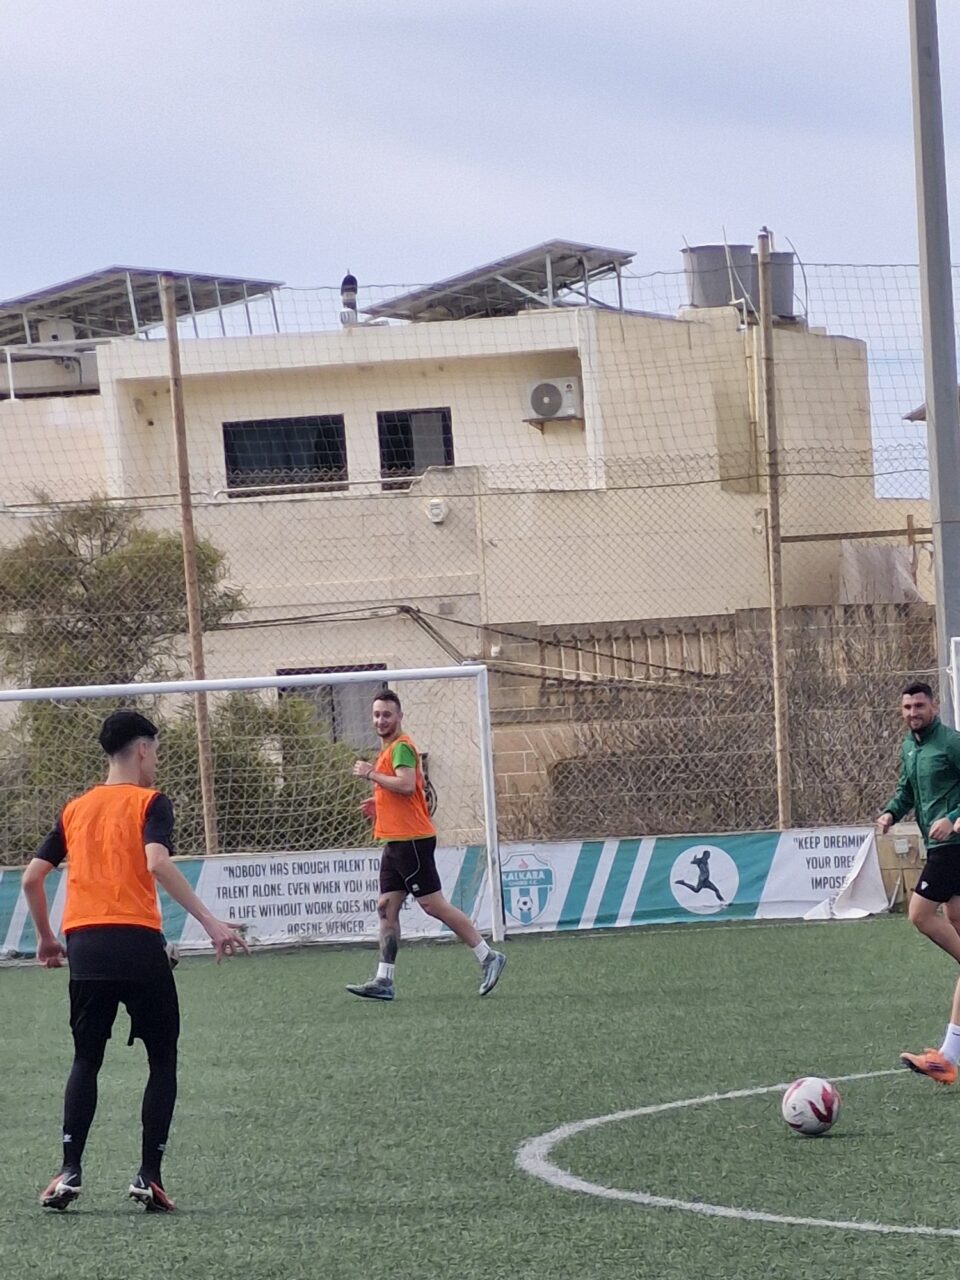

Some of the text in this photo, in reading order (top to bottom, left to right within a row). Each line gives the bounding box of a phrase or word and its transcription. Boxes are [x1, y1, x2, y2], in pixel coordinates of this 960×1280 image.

[793, 833, 868, 850] "KEEP DREAMIN
[223, 858, 380, 878] "NOBODY HAS ENOUGH TALENT TO
[805, 856, 831, 870] YOUR
[216, 879, 379, 899] TALENT ALONE. EVEN WHEN YOU HA
[229, 906, 236, 919] A
[239, 905, 256, 918] LIFE
[259, 902, 302, 917] WITHOUT
[305, 901, 333, 915] WORK
[336, 900, 360, 914] GOES
[287, 922, 323, 936] ARSENE
